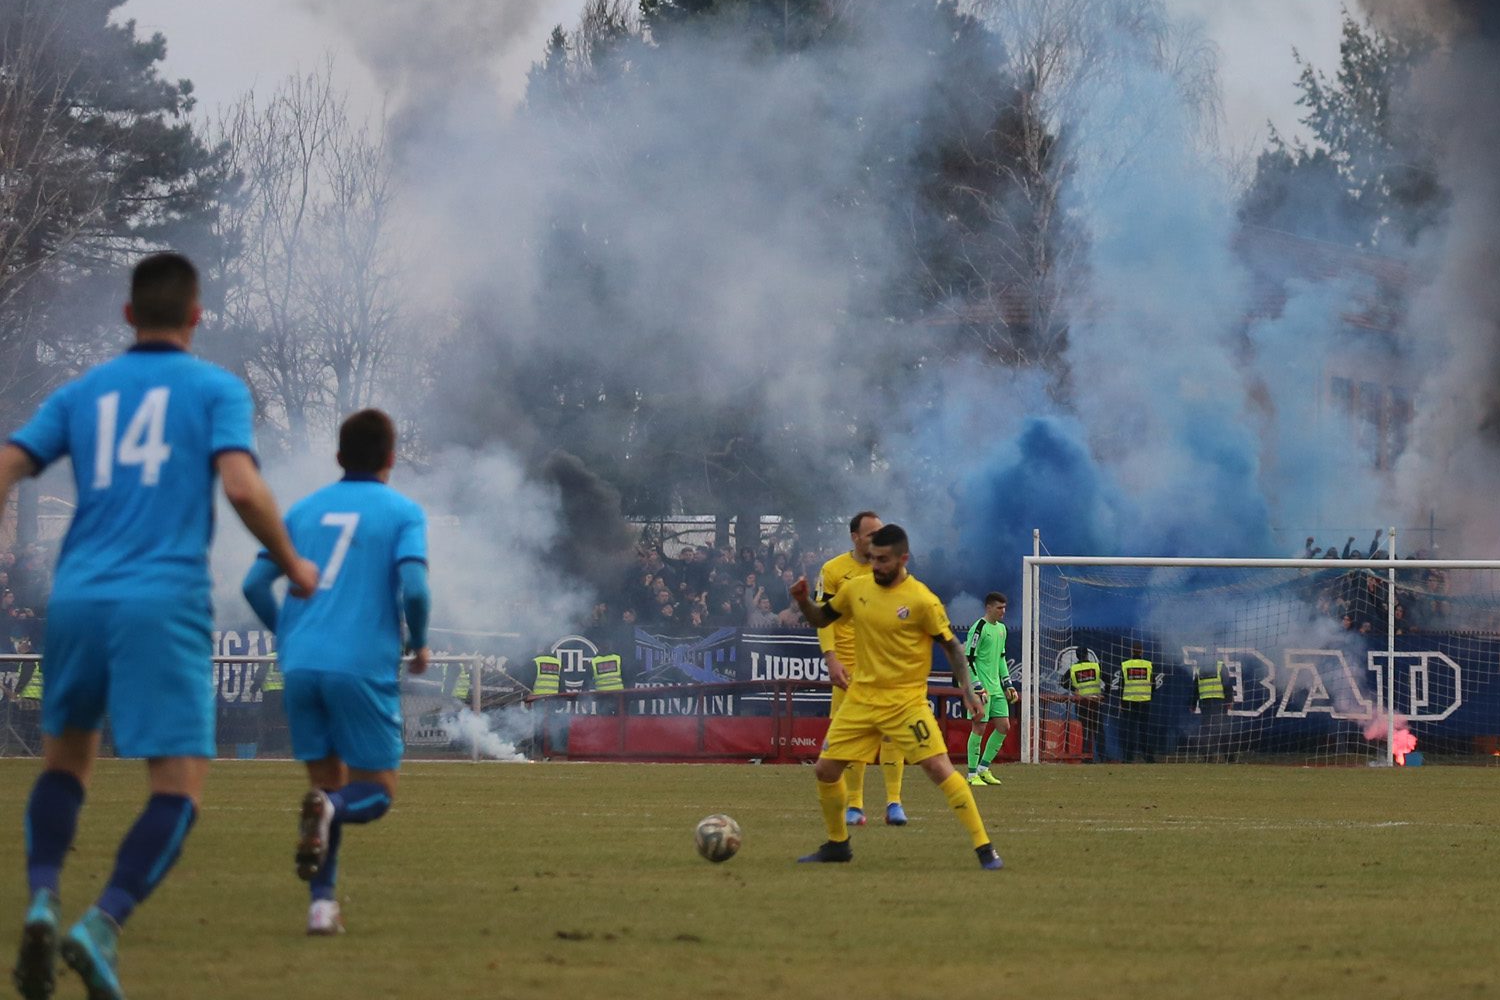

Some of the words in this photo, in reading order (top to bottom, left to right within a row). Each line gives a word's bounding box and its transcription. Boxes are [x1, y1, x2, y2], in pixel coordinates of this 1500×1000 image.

[92, 387, 171, 490] 14
[320, 512, 360, 589] 7
[1182, 646, 1463, 722] BAD
[908, 718, 931, 743] 10
